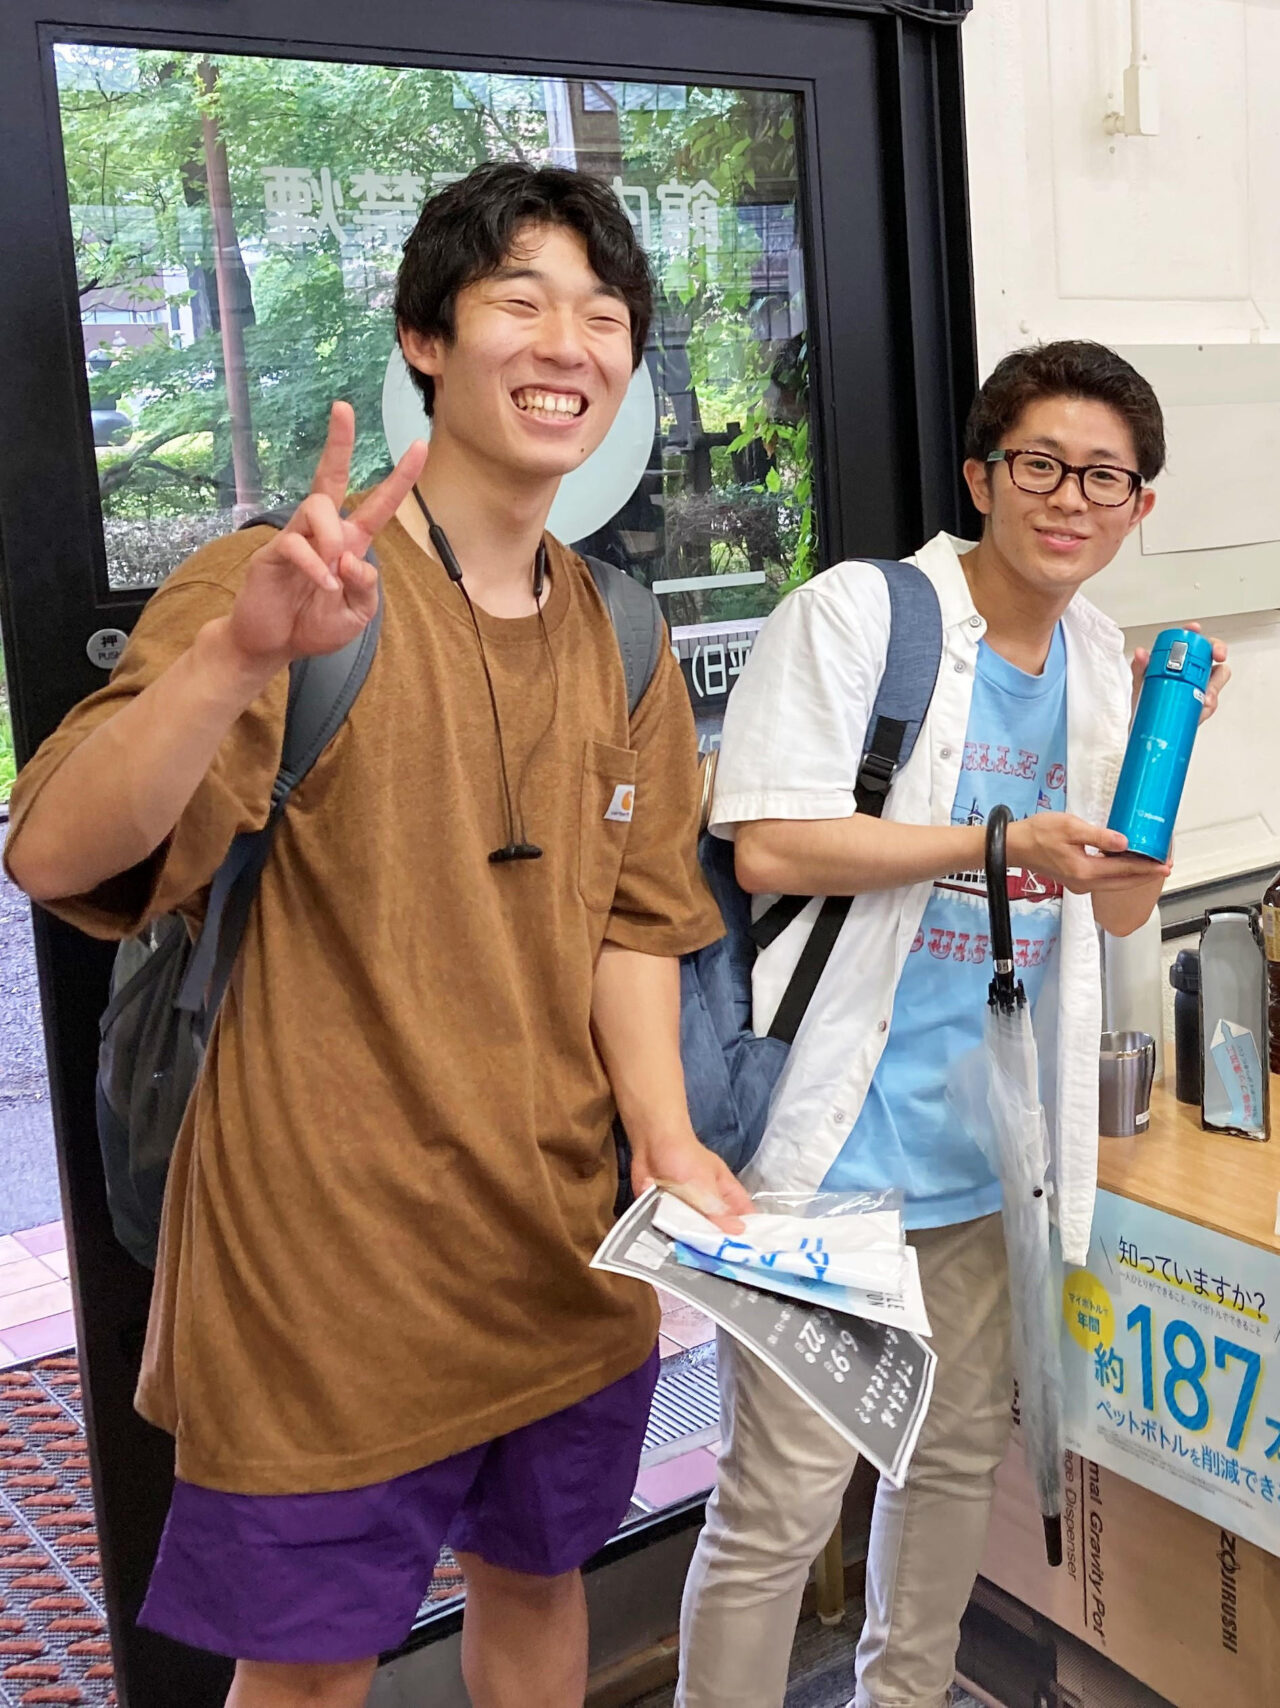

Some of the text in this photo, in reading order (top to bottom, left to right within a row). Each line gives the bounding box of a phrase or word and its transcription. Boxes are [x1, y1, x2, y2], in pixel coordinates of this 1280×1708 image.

[1119, 1236, 1265, 1319] 知っていますか?
[1077, 1311, 1100, 1335] 年間
[1064, 1487, 1077, 1583] Dispenser
[1089, 1511, 1105, 1595] Gravity
[1217, 1529, 1241, 1655] ZOJIRUSHI
